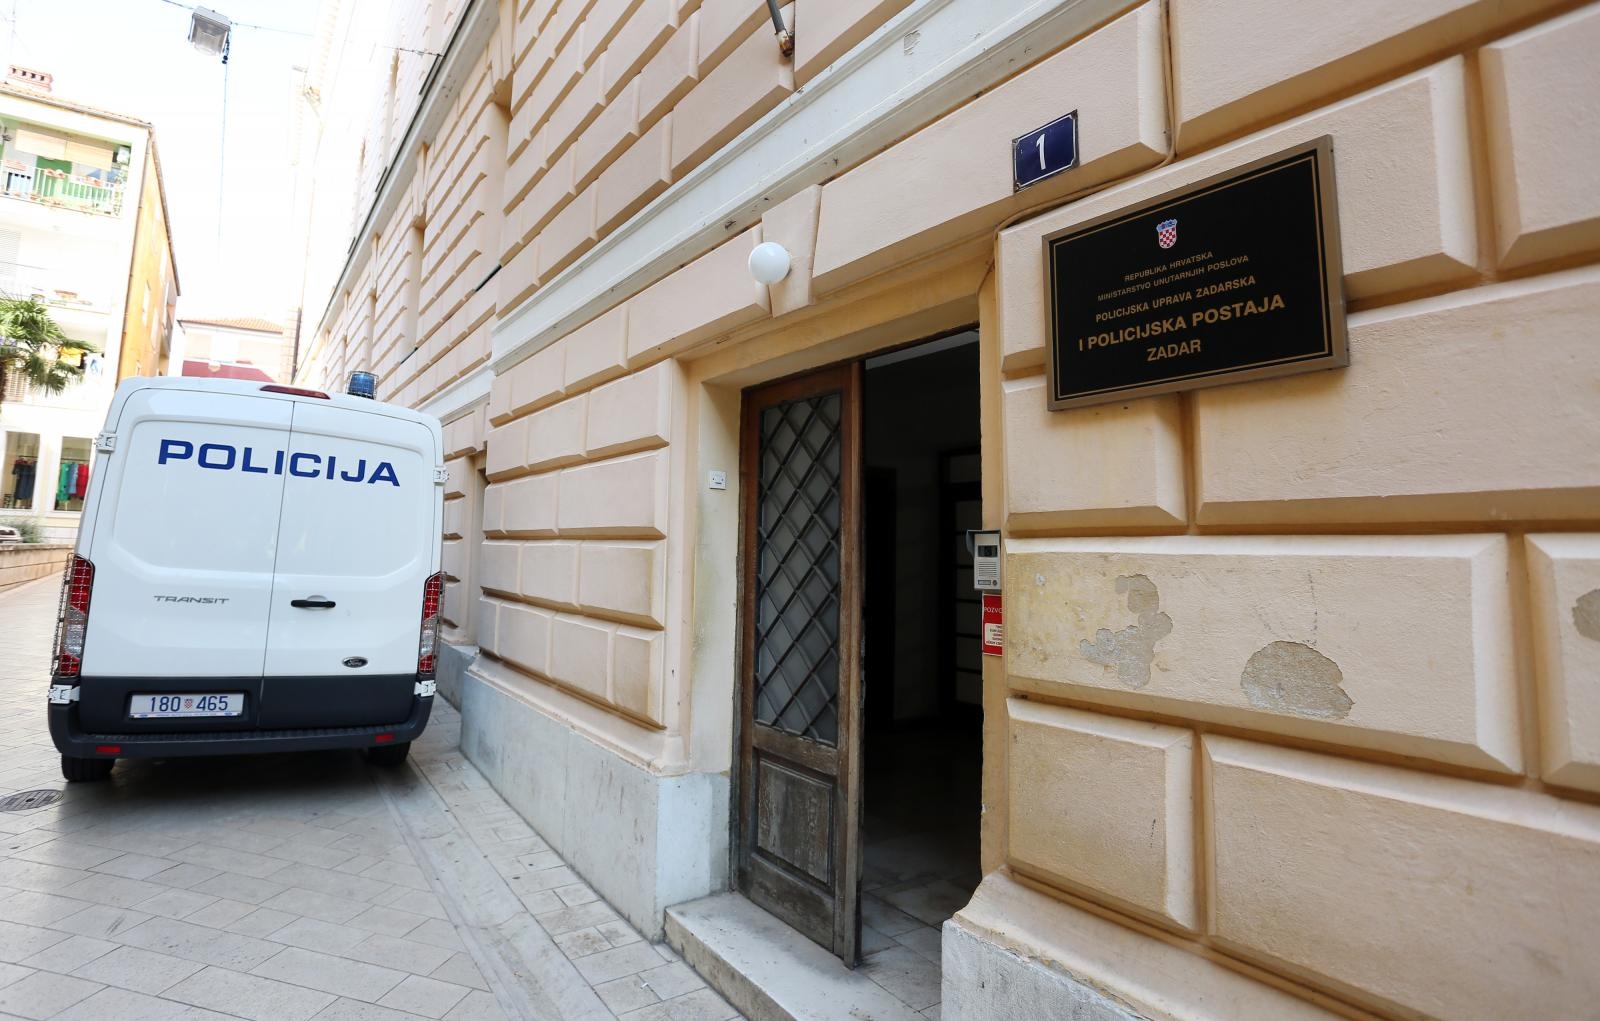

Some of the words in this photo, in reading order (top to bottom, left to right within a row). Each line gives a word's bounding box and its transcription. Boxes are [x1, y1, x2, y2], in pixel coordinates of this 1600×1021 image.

[1036, 133, 1046, 170] 1
[1097, 282, 1151, 301] MINISTARSTVO
[1153, 267, 1205, 287] UNUTARNJIH
[1207, 255, 1249, 272] POSLOVA
[1124, 264, 1167, 282] REPUBLIKA
[1169, 251, 1213, 269] HRVATSKA
[1095, 303, 1149, 323] POLICIJSKA
[1152, 291, 1193, 309] UPRAVA
[1195, 275, 1256, 298] ZADARSKA
[1078, 338, 1084, 351] I
[1087, 316, 1187, 350] POLICIJSKA
[1191, 294, 1286, 327] POSTAJA
[1147, 339, 1201, 362] ZADAR
[157, 439, 401, 487] POLICIJA
[153, 595, 230, 605] TRANSIT
[151, 696, 181, 712] 180
[196, 696, 228, 711] 465
